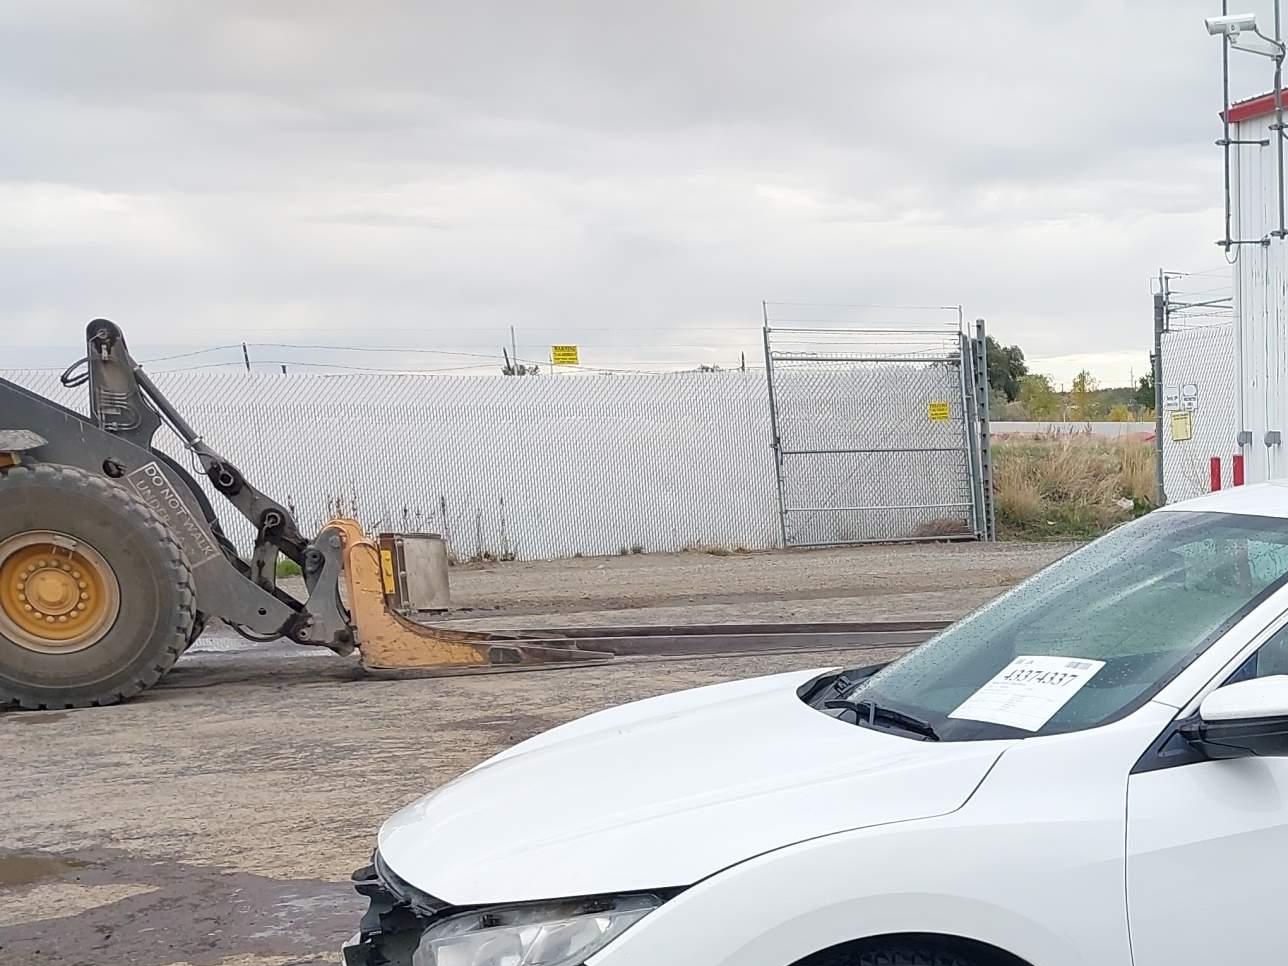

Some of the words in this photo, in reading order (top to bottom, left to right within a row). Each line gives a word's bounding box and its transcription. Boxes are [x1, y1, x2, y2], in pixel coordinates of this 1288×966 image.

[144, 465, 164, 487] DO
[160, 488, 187, 516] NOT
[183, 517, 213, 555] WALK
[1003, 669, 1078, 687] 43374337
